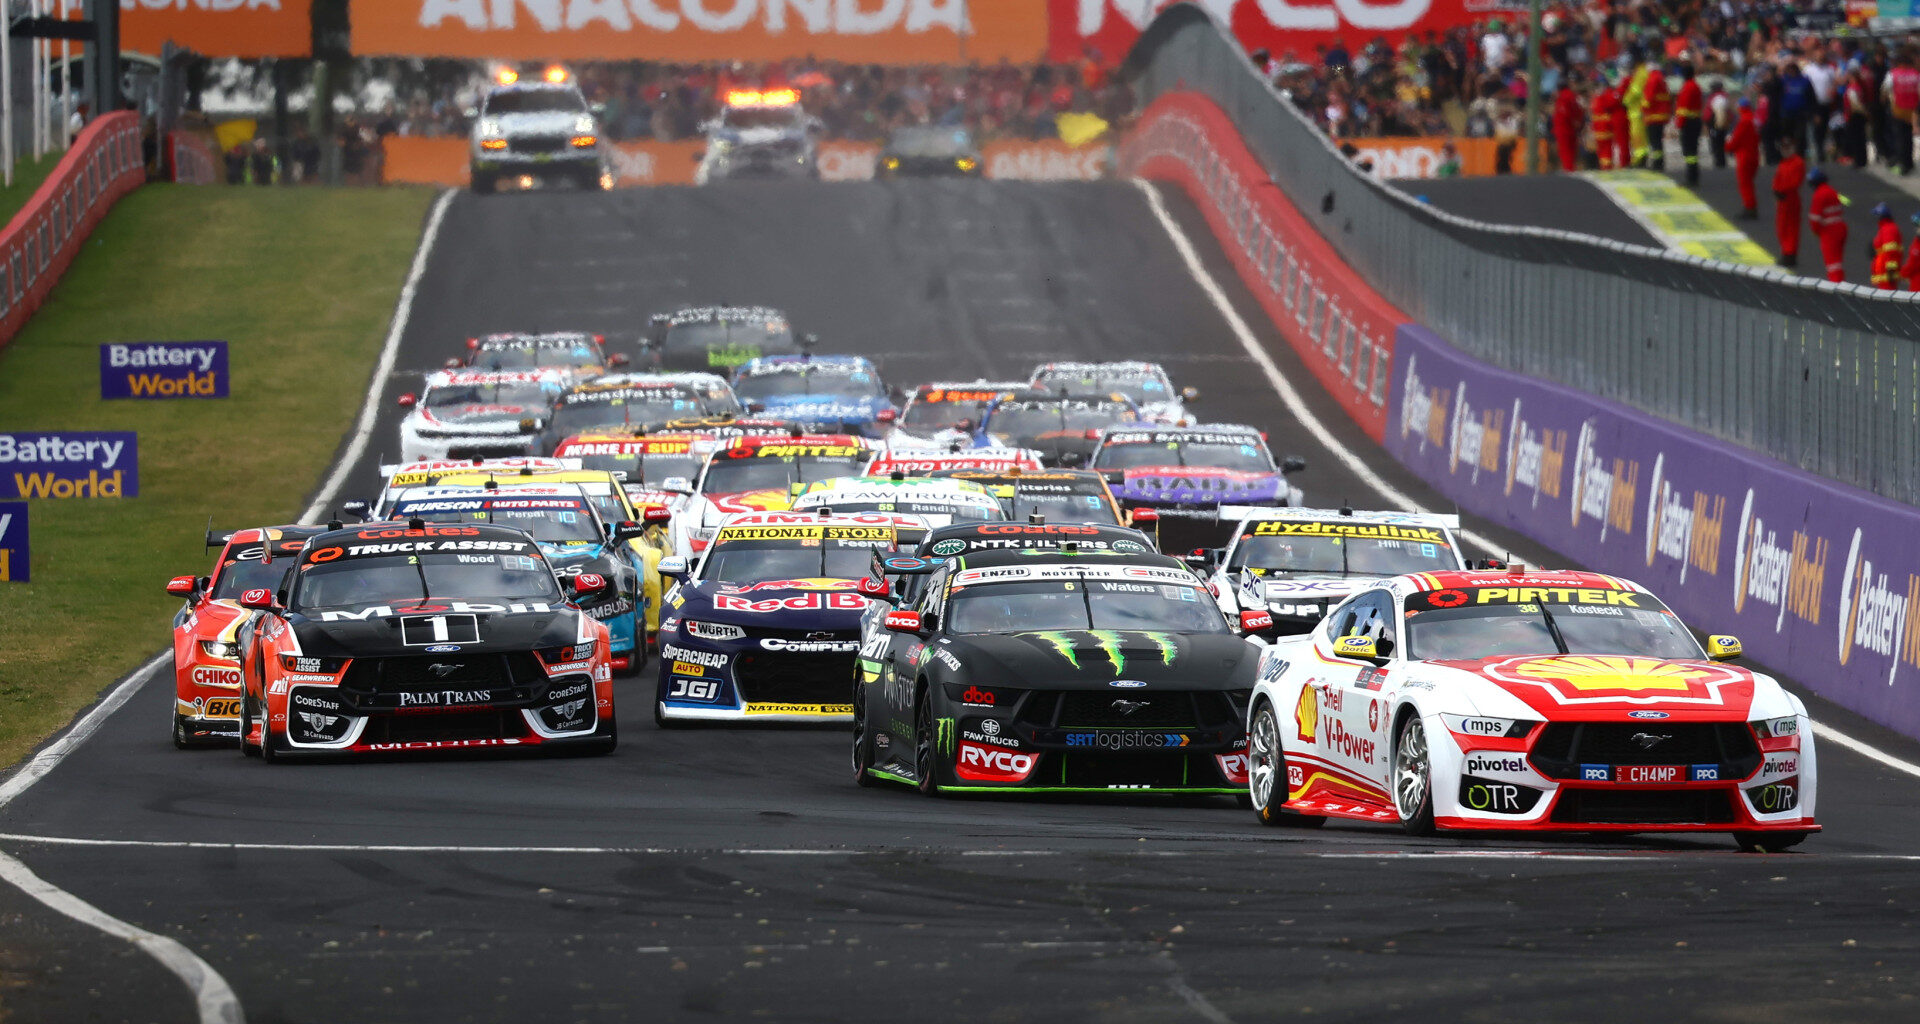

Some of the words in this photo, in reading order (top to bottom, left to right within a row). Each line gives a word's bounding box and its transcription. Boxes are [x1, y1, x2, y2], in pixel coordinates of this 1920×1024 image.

[110, 344, 217, 372] Battery
[128, 371, 216, 396] World
[0, 434, 124, 470] Battery
[563, 443, 620, 456] MAKE
[623, 443, 644, 454] IT
[647, 443, 688, 454] SUP
[15, 469, 122, 498] World
[1018, 484, 1072, 492] tteries
[402, 501, 483, 513] BURSON
[492, 500, 530, 508] AUTO
[530, 500, 575, 508] PARTS
[471, 511, 487, 519] 10
[357, 527, 481, 540] Coates
[722, 528, 818, 540] NATIONAL
[828, 528, 891, 539] STORA
[977, 525, 1100, 535] Coates
[1254, 520, 1443, 541] Hydraulink
[347, 541, 438, 556] TRUCK
[438, 541, 528, 552] ASSIST
[970, 539, 1021, 550] NTK
[1378, 540, 1400, 548] Hill
[407, 555, 419, 564] 2
[457, 554, 495, 563] Wood
[981, 569, 1025, 578] ENZED
[1147, 570, 1191, 581] ENZED
[1748, 517, 1792, 634] Battery
[1064, 582, 1075, 591] 6
[1100, 582, 1155, 593] Waters
[1470, 578, 1511, 586] Shell
[713, 592, 822, 613] Red
[1476, 588, 1640, 607] PIRTEK
[321, 602, 551, 622] Mobil
[1517, 604, 1539, 613] 38
[1569, 604, 1624, 616] Kostecki
[885, 616, 920, 627] RYCO
[1855, 560, 1908, 687] Battery
[424, 616, 449, 642] 1
[662, 643, 728, 669] SUPERCHEAP
[1340, 645, 1370, 654] Doric
[296, 657, 322, 665] TRUCK
[295, 664, 321, 673] ASSIST
[675, 663, 701, 674] AUTO
[194, 669, 241, 684] CHIKO
[291, 674, 335, 683] GEARWRENCH
[670, 679, 718, 699] JGI
[963, 686, 995, 704] dba
[399, 691, 439, 707] PALM
[442, 690, 491, 706] TRANS
[747, 704, 818, 713] NATIONAL
[1470, 720, 1502, 734] mps
[1779, 720, 1797, 734] mps
[963, 730, 984, 741] FAW
[984, 735, 1020, 748] TRUCKS
[1323, 714, 1375, 765] V-Power
[961, 745, 1032, 774] RYCO
[1221, 755, 1250, 774] RY
[1585, 769, 1608, 780] PPQ
[1630, 767, 1677, 782] CH4MP
[1697, 769, 1718, 780] PPQ
[1468, 784, 1520, 810] OTR
